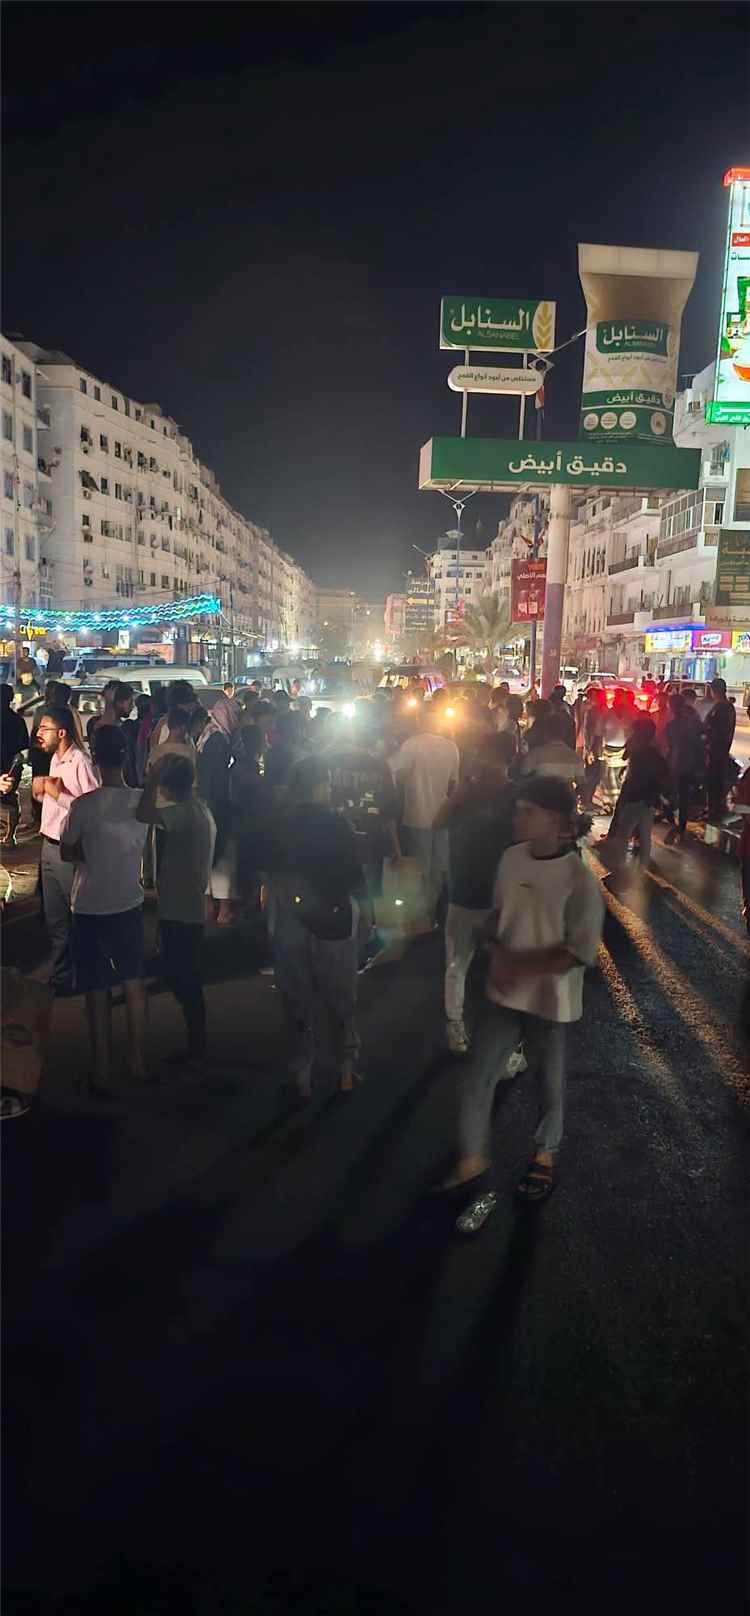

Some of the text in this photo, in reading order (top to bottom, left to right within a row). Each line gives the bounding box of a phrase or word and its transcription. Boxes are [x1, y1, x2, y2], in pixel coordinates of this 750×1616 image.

[450, 304, 529, 336] السنابل
[603, 326, 663, 346] السنابل
[606, 391, 661, 406] دقيق أبيض
[509, 451, 628, 476] دقيق أبيض
